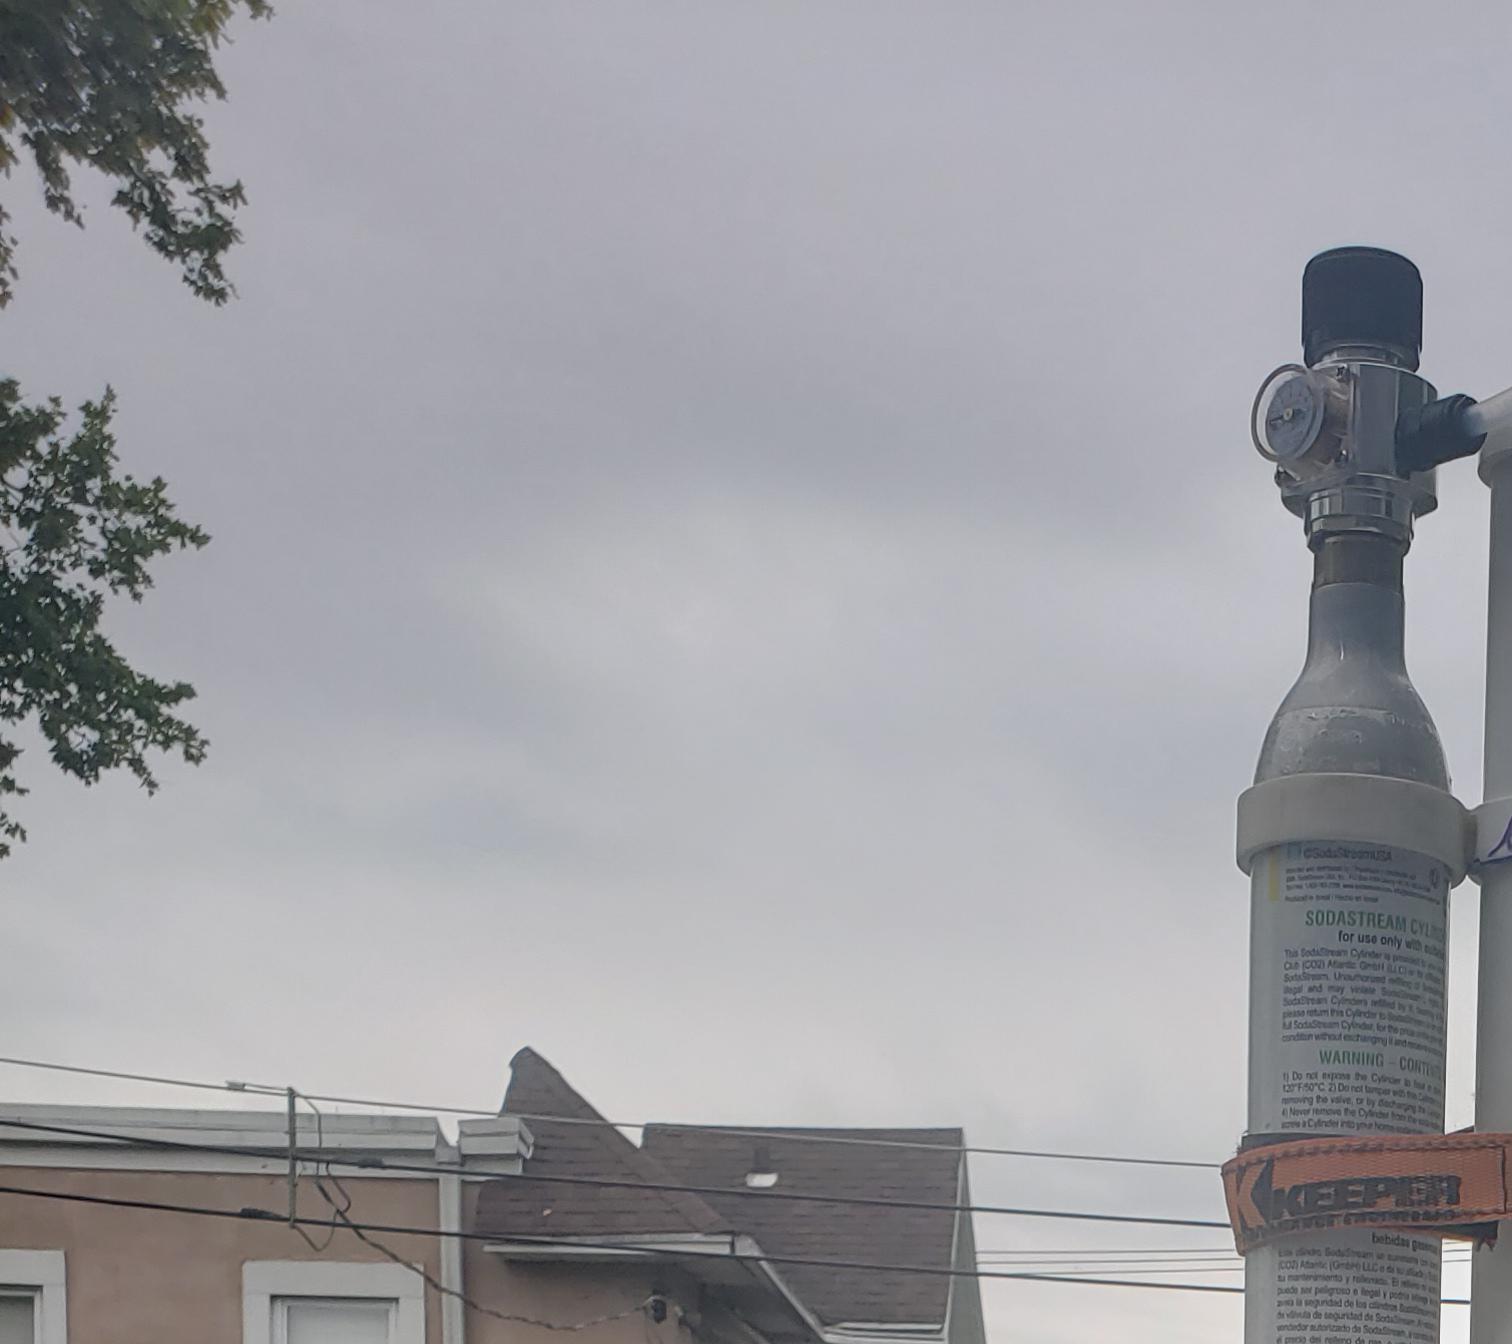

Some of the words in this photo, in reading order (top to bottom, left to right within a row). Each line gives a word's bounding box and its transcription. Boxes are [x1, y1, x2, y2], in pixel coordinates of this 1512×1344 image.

[1305, 909, 1406, 932] SODASTREAM
[1338, 930, 1353, 942] for
[1358, 933, 1377, 944] use
[1381, 936, 1402, 950] only
[1319, 1050, 1384, 1067] WARNING
[1371, 1232, 1410, 1248] bebidas
